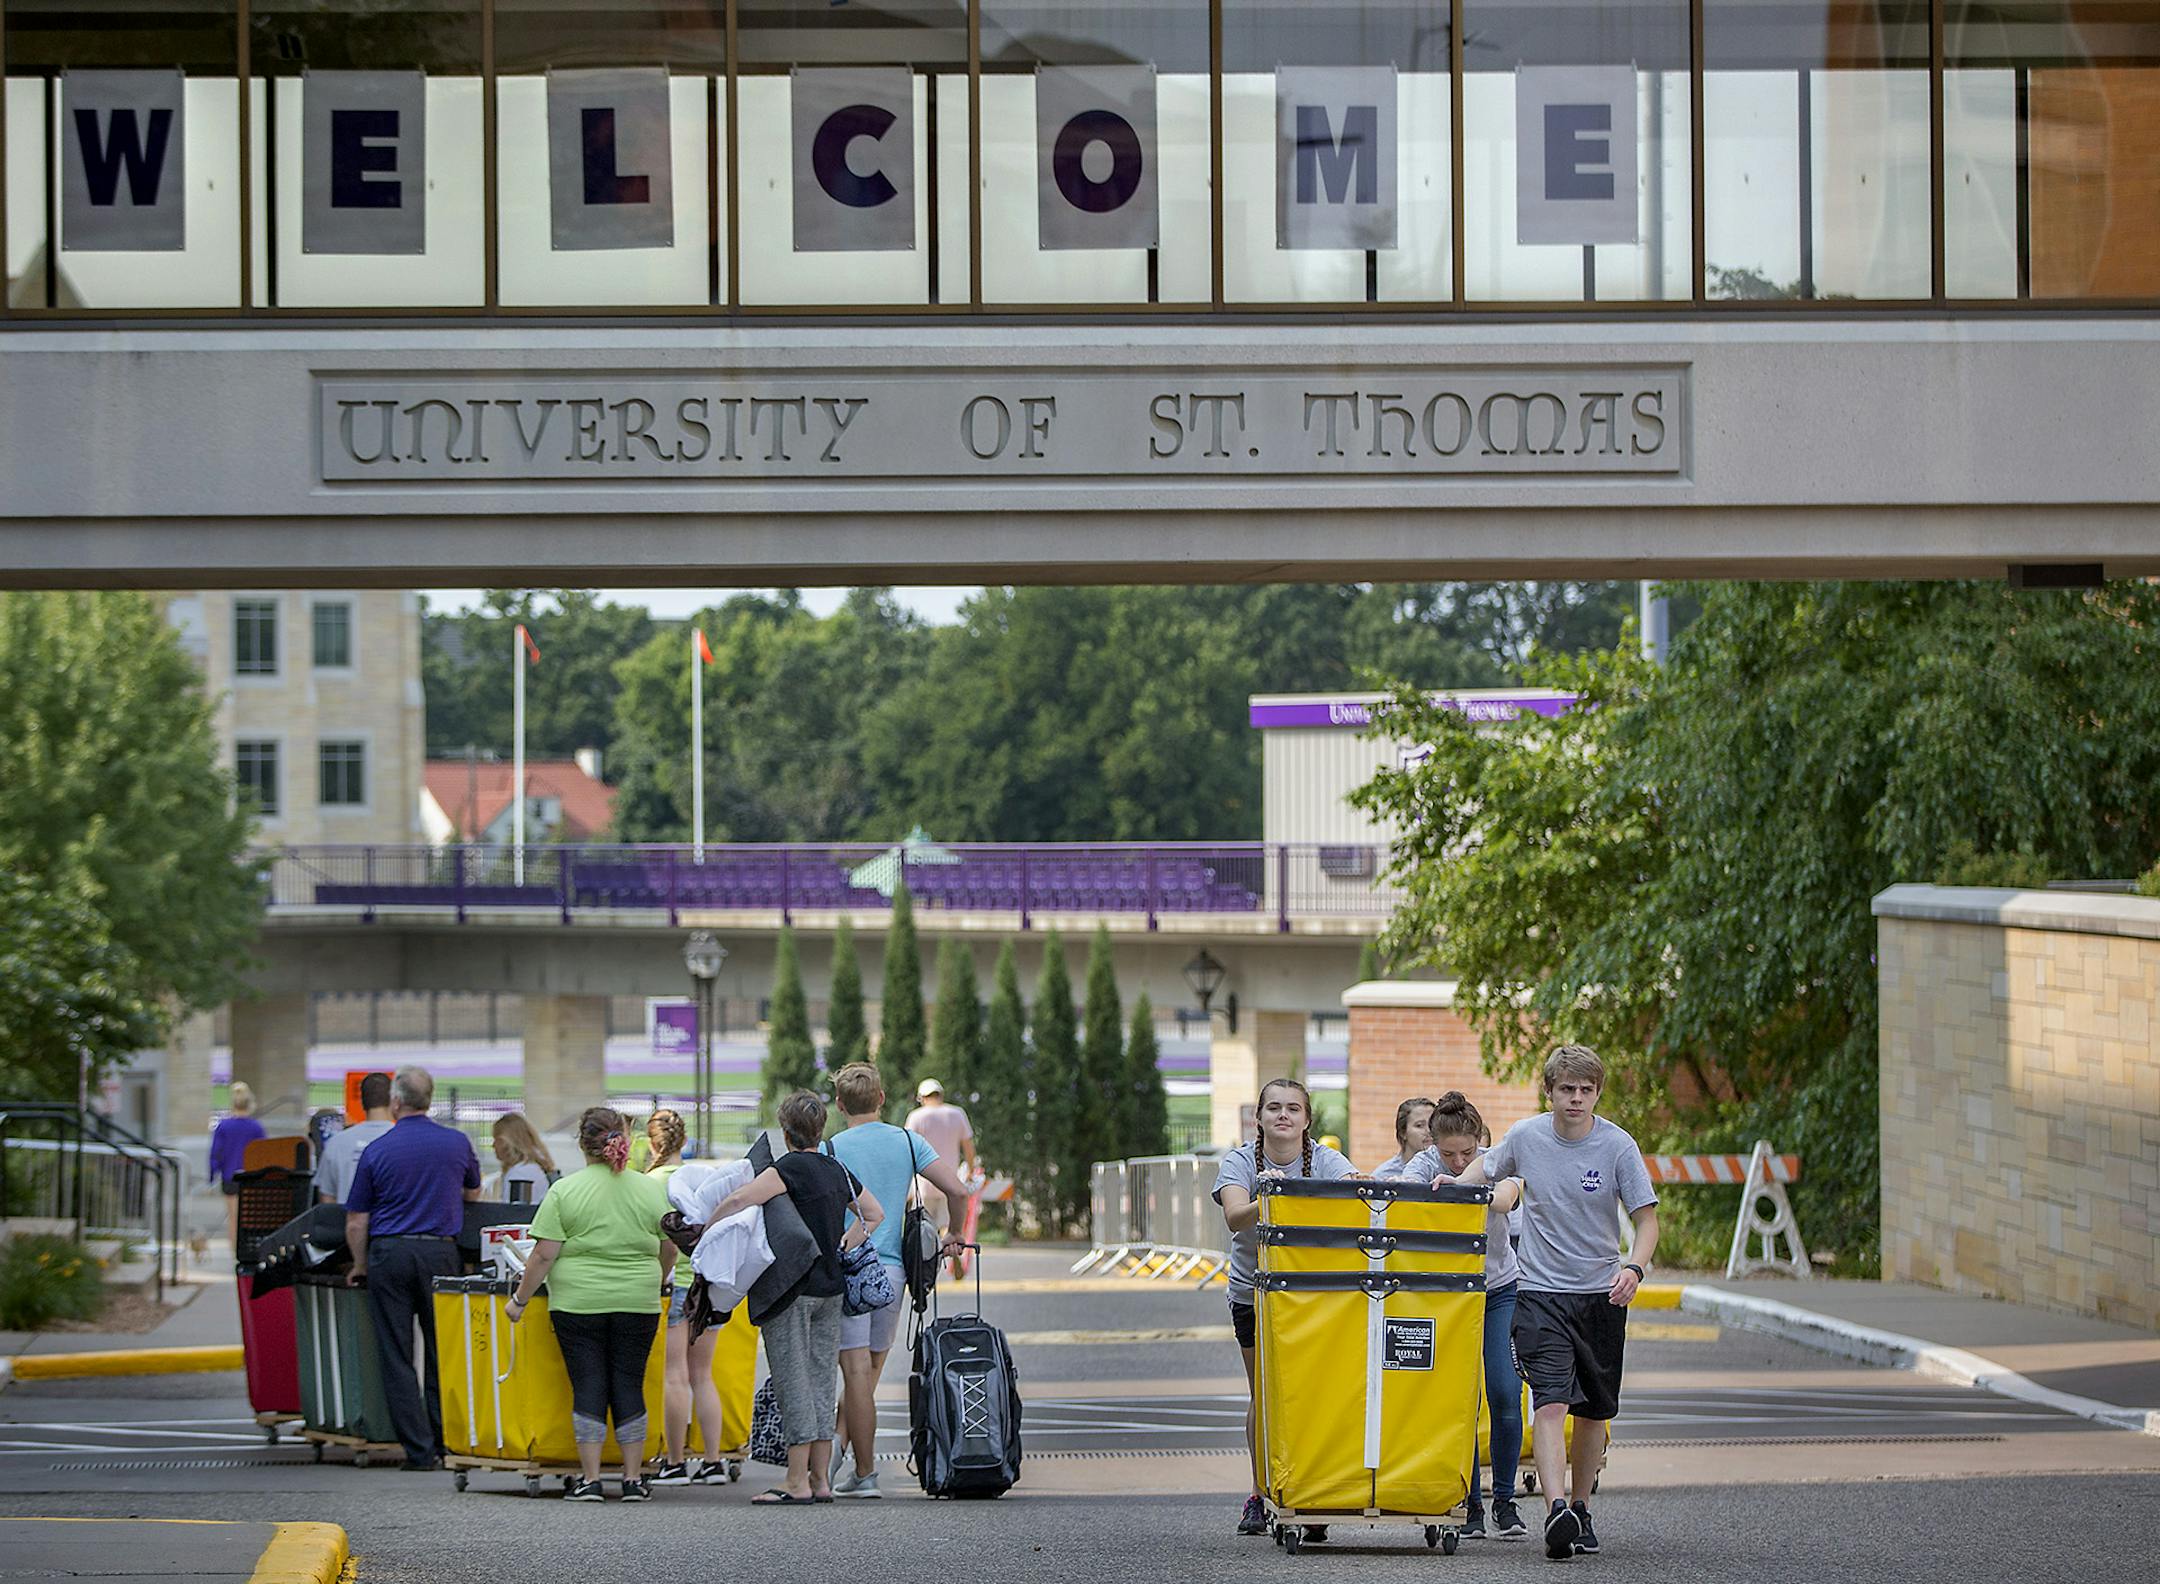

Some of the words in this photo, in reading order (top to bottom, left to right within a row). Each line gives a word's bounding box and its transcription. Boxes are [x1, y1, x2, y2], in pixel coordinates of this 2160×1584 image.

[74, 104, 1614, 213] WELCOME
[337, 396, 868, 464] UNIVERSITY
[960, 395, 1057, 460] OF
[1149, 392, 1259, 458] ST.
[1303, 389, 1667, 458] THOMAS
[1397, 1326, 1430, 1334] American
[1395, 1350, 1422, 1361] ROYAL
